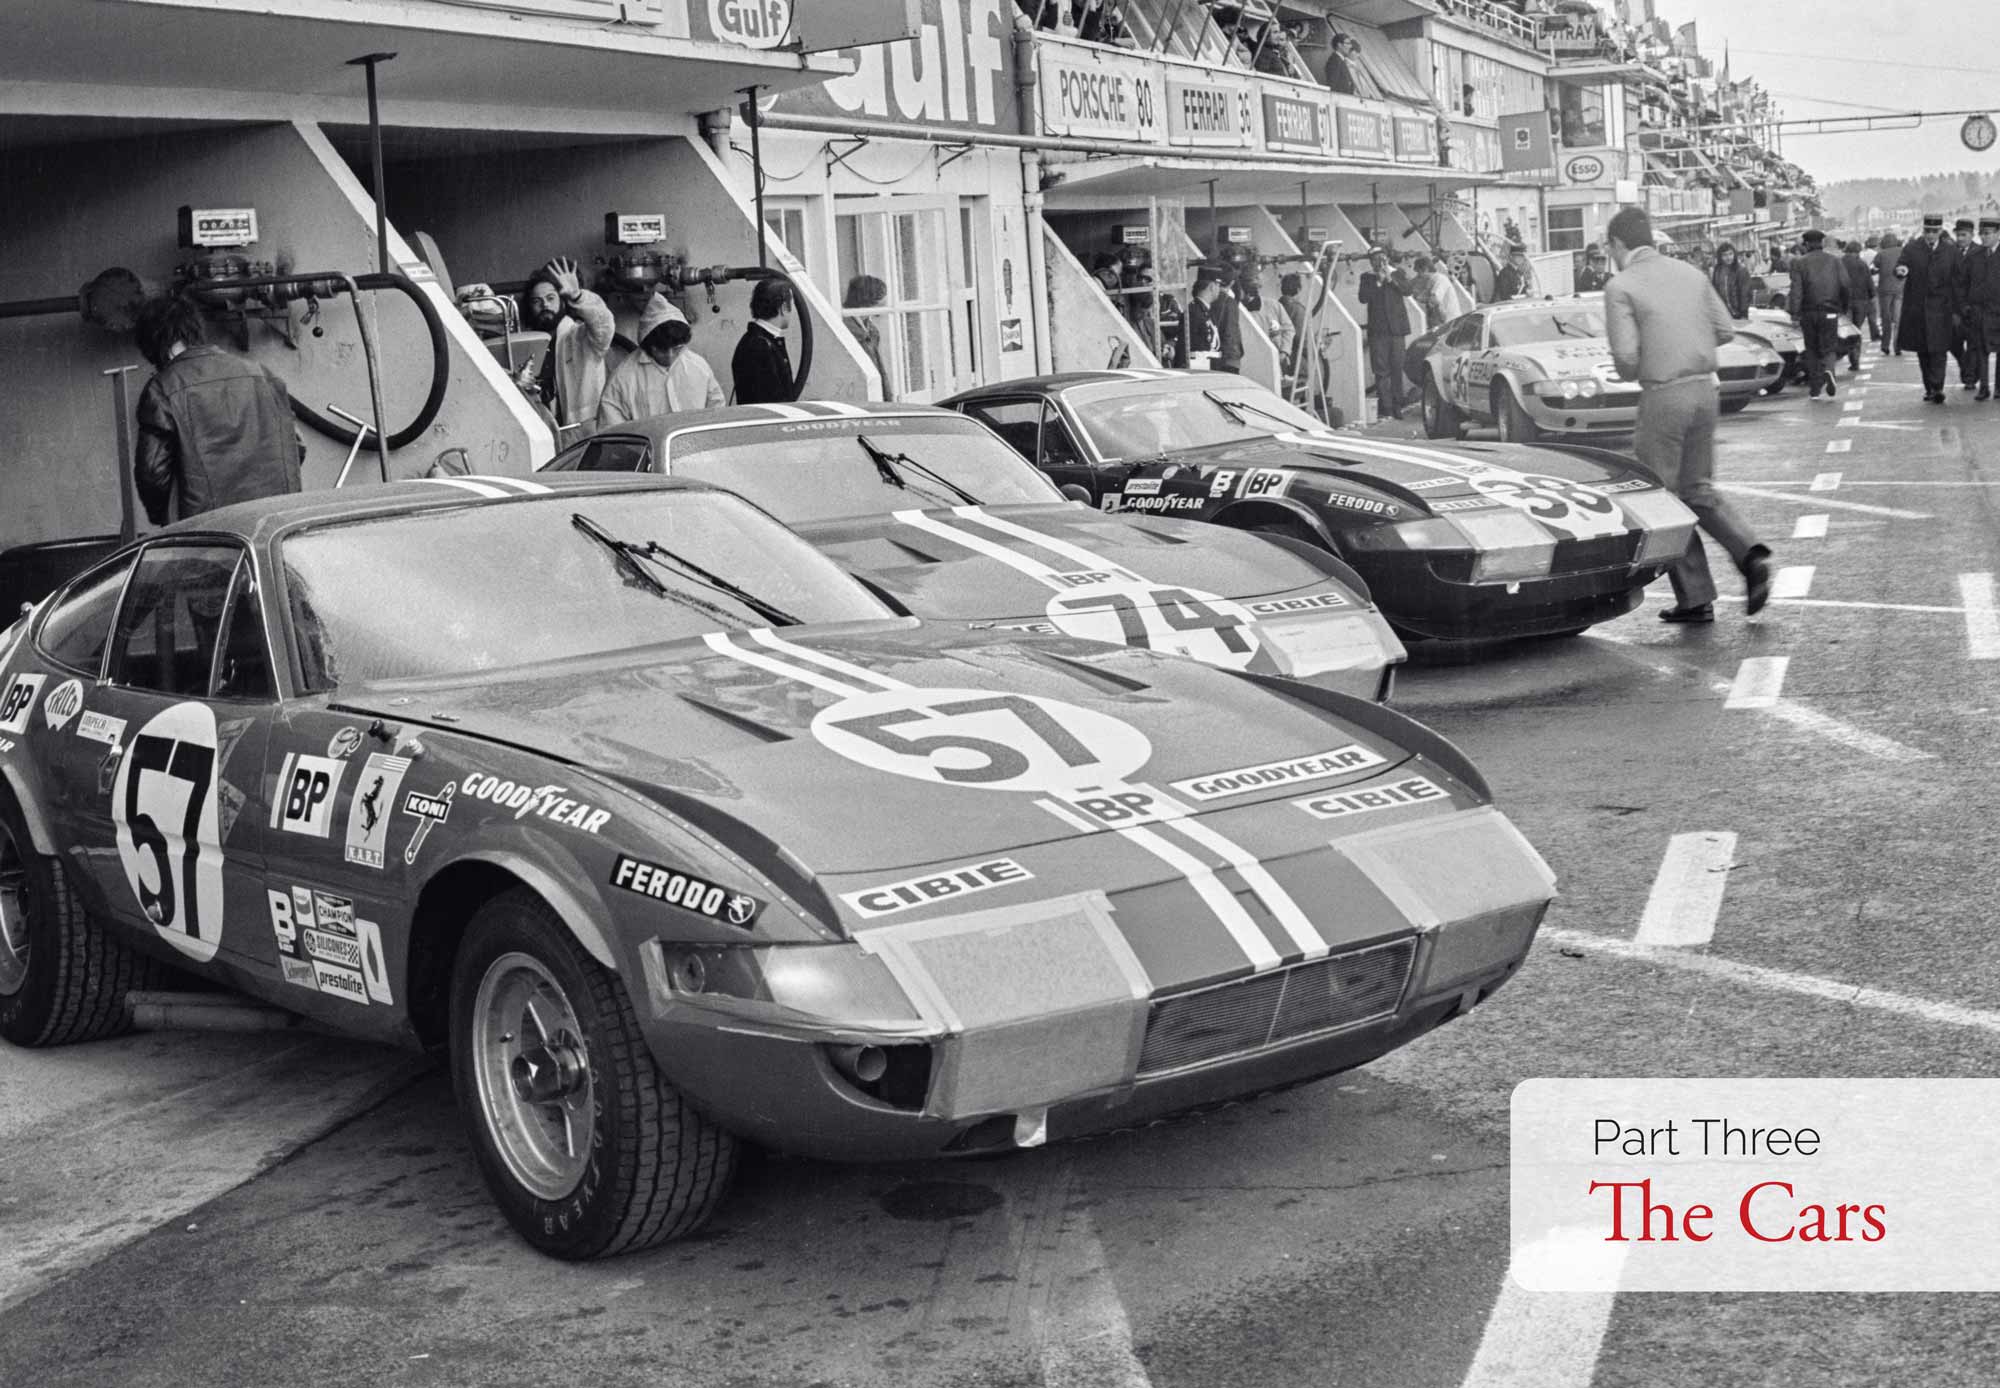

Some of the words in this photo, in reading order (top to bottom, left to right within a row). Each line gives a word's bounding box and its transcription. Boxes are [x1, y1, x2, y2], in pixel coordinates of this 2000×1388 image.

[717, 0, 783, 38] Gulf
[1059, 69, 1126, 122] PORSCHE
[1135, 77, 1153, 128] 80
[1182, 88, 1230, 132] FERRARI
[1237, 91, 1252, 134] 36
[1275, 100, 1313, 142] FERRARI
[781, 419, 901, 433] GOODYEAR
[1248, 472, 1283, 495] BP
[1126, 494, 1205, 512] GOODYEAR
[1327, 492, 1384, 514] FERODO
[1063, 569, 1113, 587] BP
[1058, 588, 1254, 654] 74
[1251, 593, 1344, 614] CIBIE
[0, 684, 35, 723] BP
[47, 681, 79, 717] TRICO
[826, 695, 1101, 784] 57
[1190, 750, 1368, 795] GOODYEAR
[286, 768, 330, 823] BP
[408, 794, 446, 820] KONI
[461, 772, 612, 834] GOODYEAR
[1075, 792, 1154, 822] BP
[1308, 779, 1442, 815] CIBIE
[126, 734, 215, 940] 57
[615, 858, 724, 916] FERODO
[857, 860, 1028, 912] CIBIE
[318, 904, 352, 924] CHAMPION
[319, 971, 363, 996] prestolite
